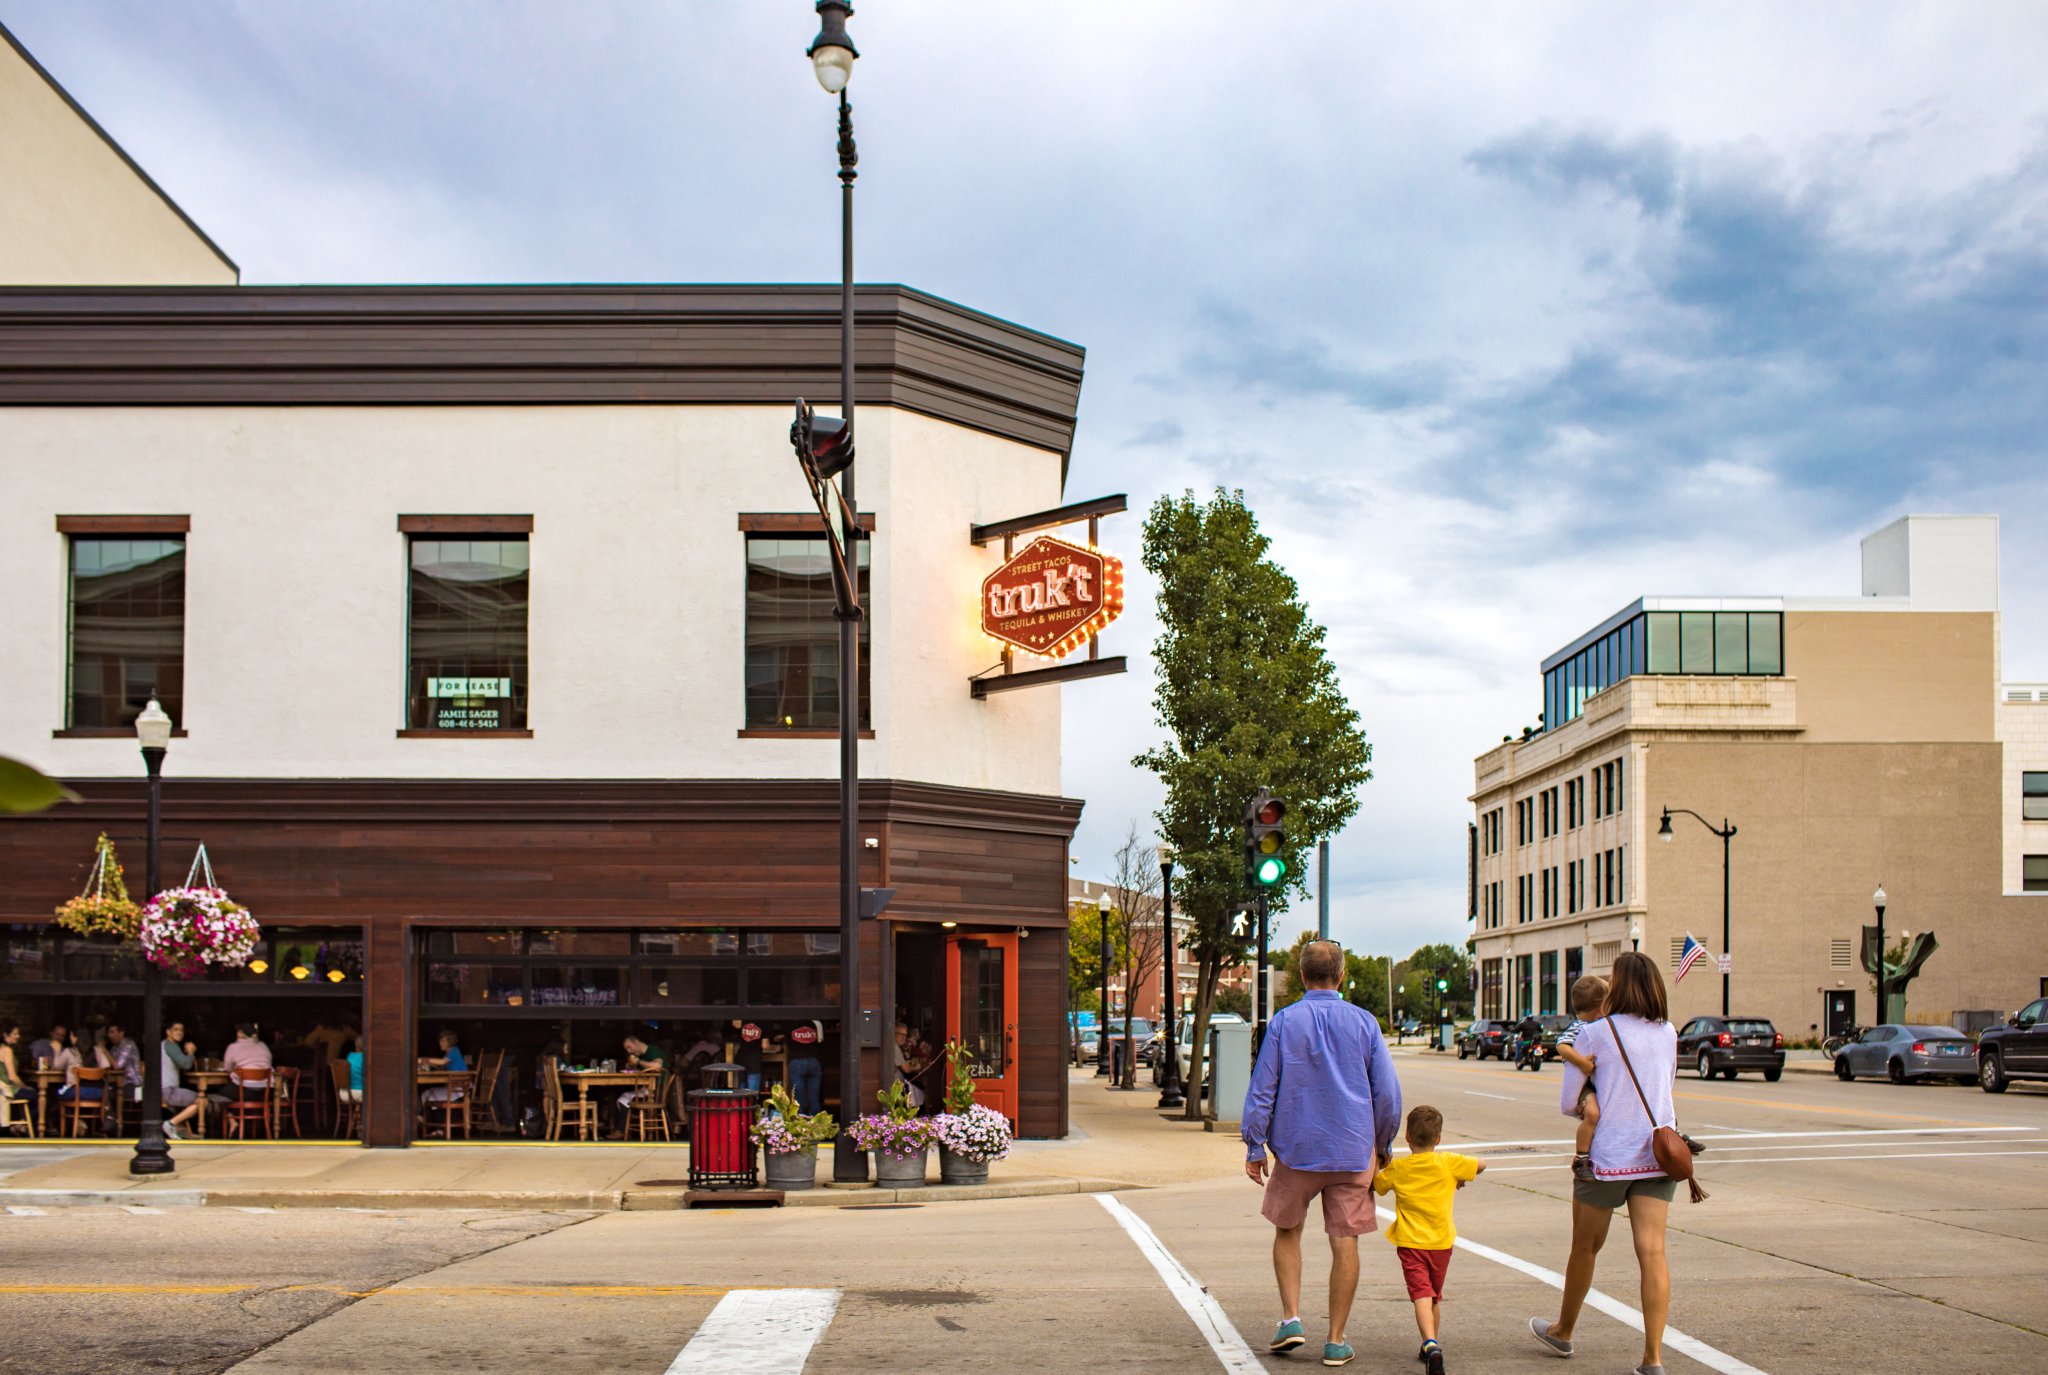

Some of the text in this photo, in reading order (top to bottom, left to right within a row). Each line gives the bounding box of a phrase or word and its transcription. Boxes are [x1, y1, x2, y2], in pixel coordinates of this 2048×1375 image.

[1012, 555, 1072, 576] STREET TACOS
[988, 563, 1093, 618] truk't
[1000, 607, 1088, 631] TEQUILA & WHISKEY
[438, 682, 460, 690] FOR
[438, 709, 499, 718] JAMIE SAGER
